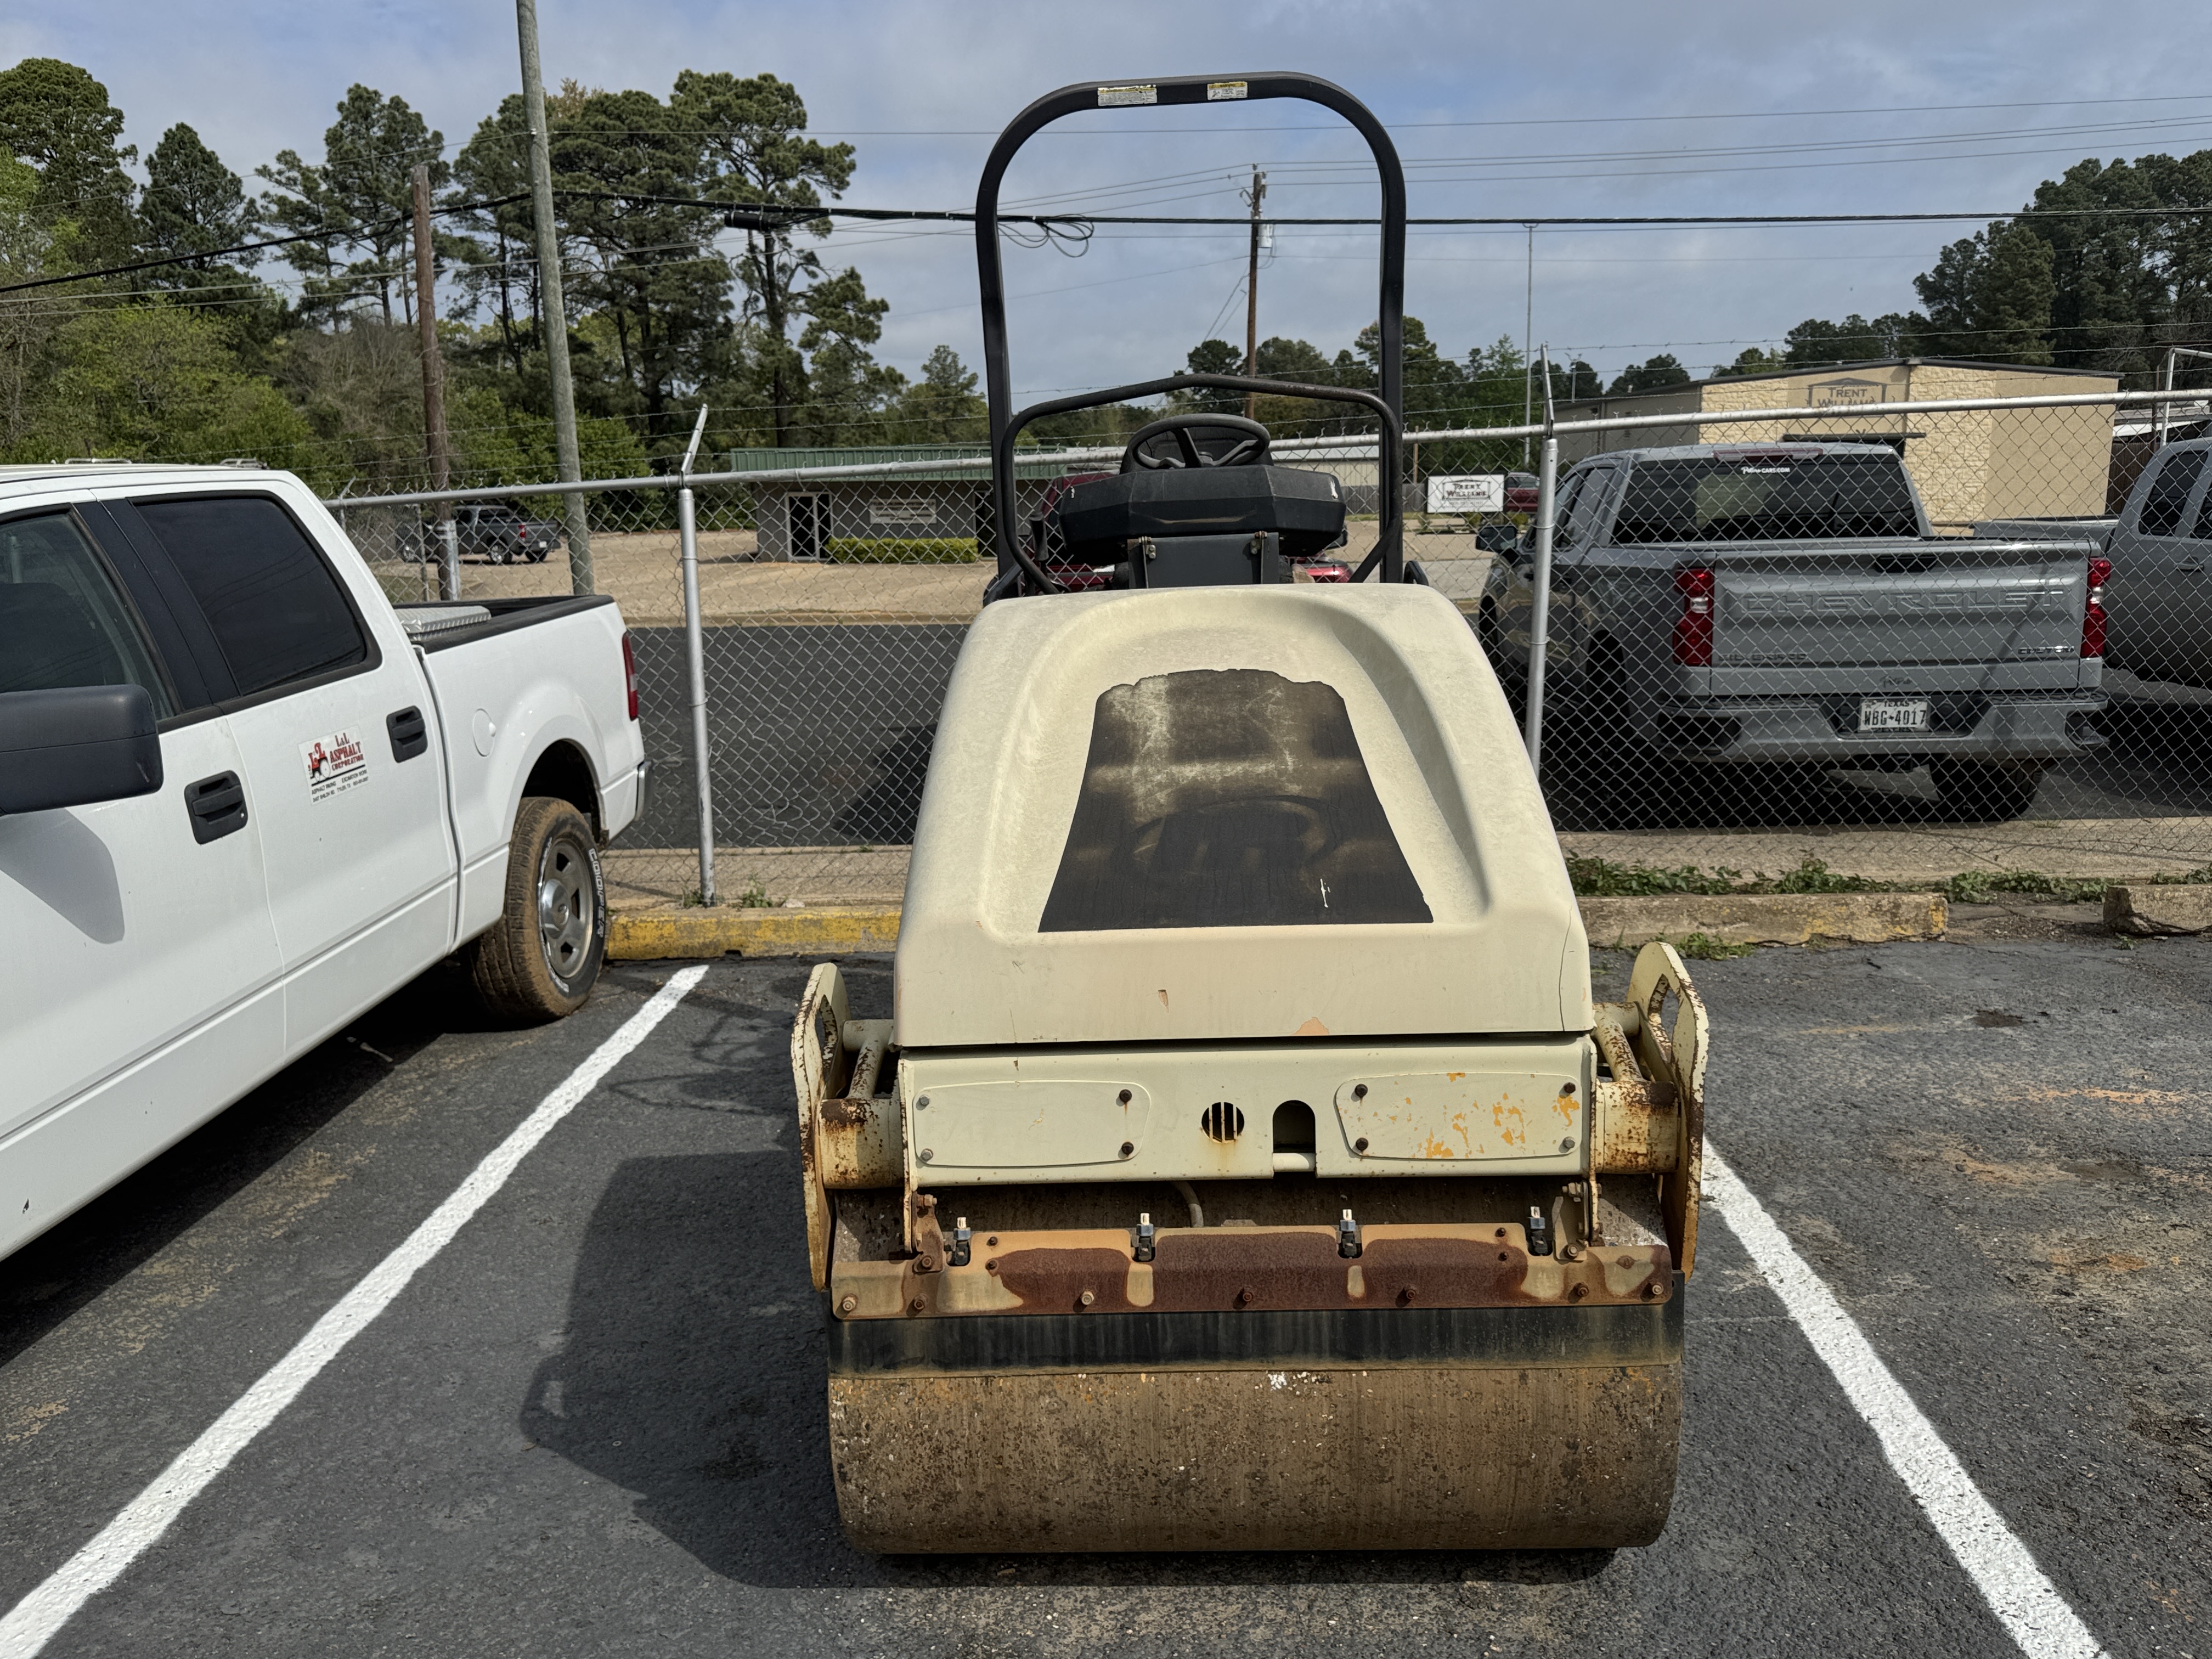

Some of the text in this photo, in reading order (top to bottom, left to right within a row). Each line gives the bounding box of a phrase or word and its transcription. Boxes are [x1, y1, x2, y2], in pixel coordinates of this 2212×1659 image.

[1828, 387, 1867, 397] TRENT
[1741, 590, 2063, 613] CHEVROLET
[2018, 646, 2075, 654] CUSTOM
[335, 732, 349, 747] L&L
[330, 741, 361, 763] ASPHALT
[331, 754, 364, 771] CORPORATION
[589, 848, 605, 938] COOPER
